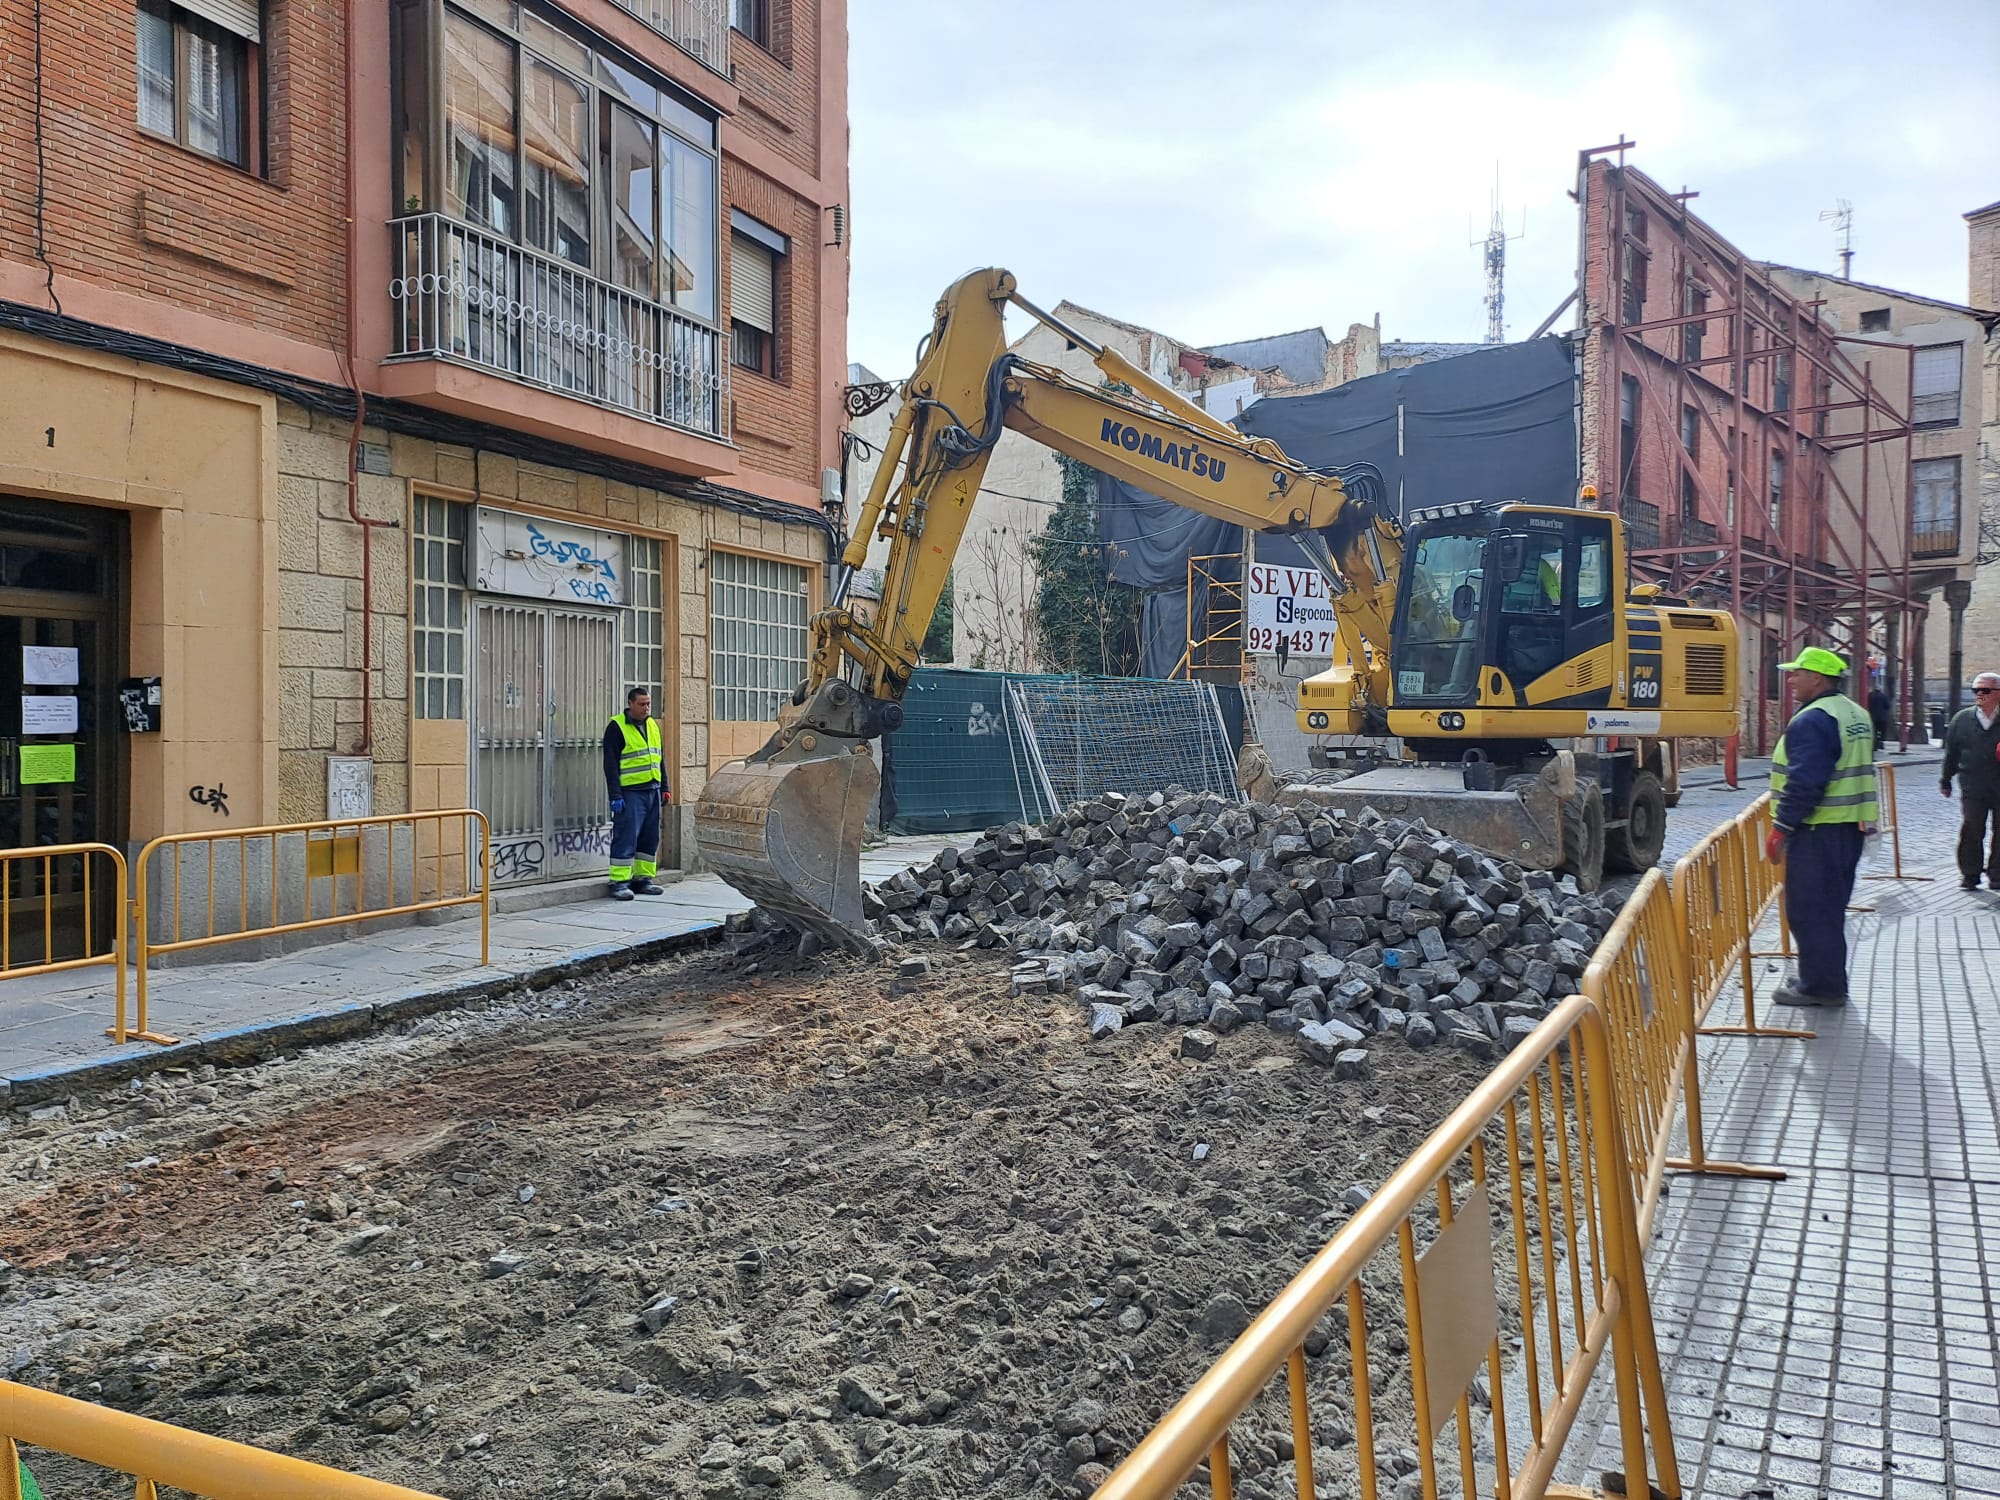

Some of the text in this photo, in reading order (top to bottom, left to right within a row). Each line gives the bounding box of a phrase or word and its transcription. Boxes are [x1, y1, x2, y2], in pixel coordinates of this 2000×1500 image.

[45, 426, 55, 448] 1
[1100, 418, 1227, 483] KOMATSU
[1529, 518, 1564, 529] KOMATSU
[1250, 567, 1280, 595] SE
[1277, 597, 1336, 624] Segocon
[1290, 630, 1314, 652] 43
[1633, 666, 1654, 679] PW
[1632, 681, 1658, 698] 180
